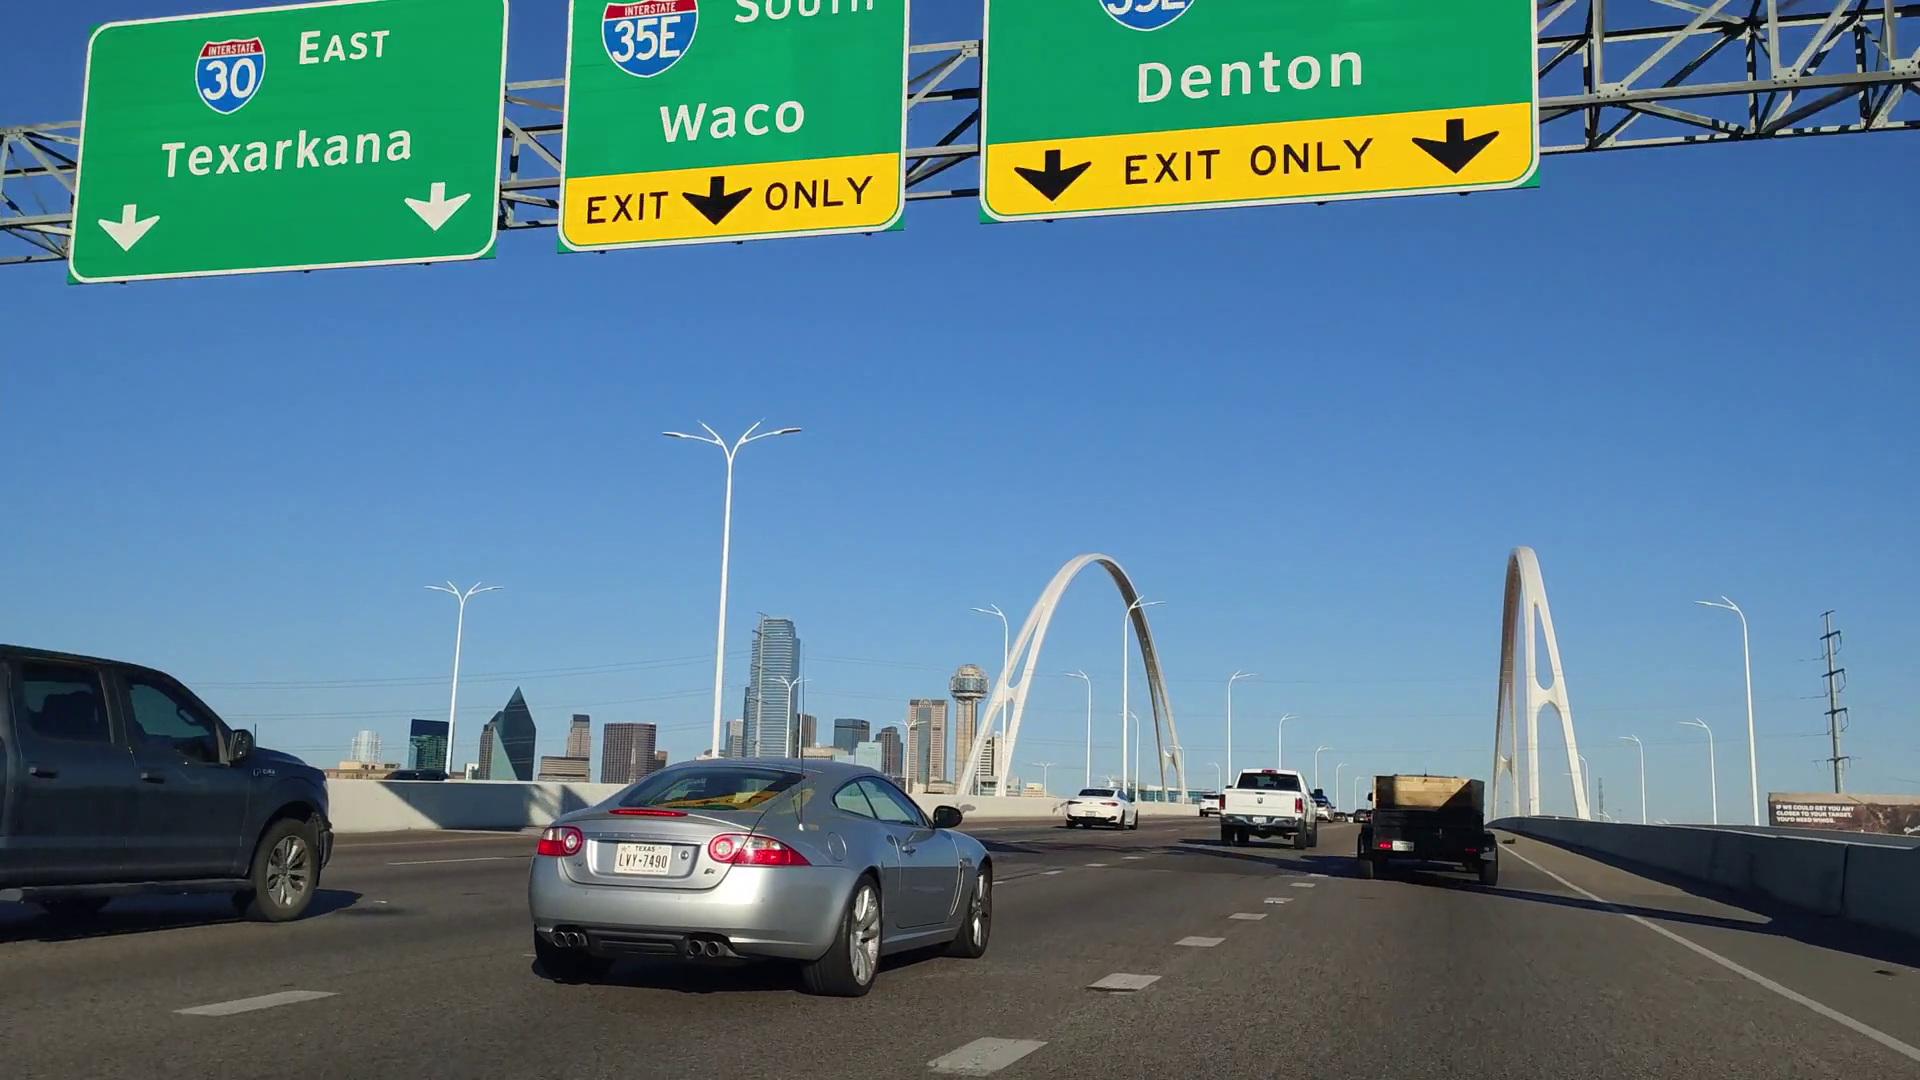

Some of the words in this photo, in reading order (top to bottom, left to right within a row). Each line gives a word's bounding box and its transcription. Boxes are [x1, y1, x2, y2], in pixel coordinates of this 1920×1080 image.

[624, 2, 677, 16] INTERSTATE
[208, 42, 256, 57] INTERSTATE
[299, 30, 390, 65] EAST
[612, 15, 681, 63] 35E
[203, 57, 256, 101] 30
[1138, 51, 1363, 103] Denton
[660, 100, 805, 143] Waco
[161, 128, 411, 178] Texarkana
[1124, 148, 1220, 185] EXIT
[1249, 137, 1374, 177] ONLY
[586, 191, 669, 224] EXIT
[765, 175, 874, 211] ONLY
